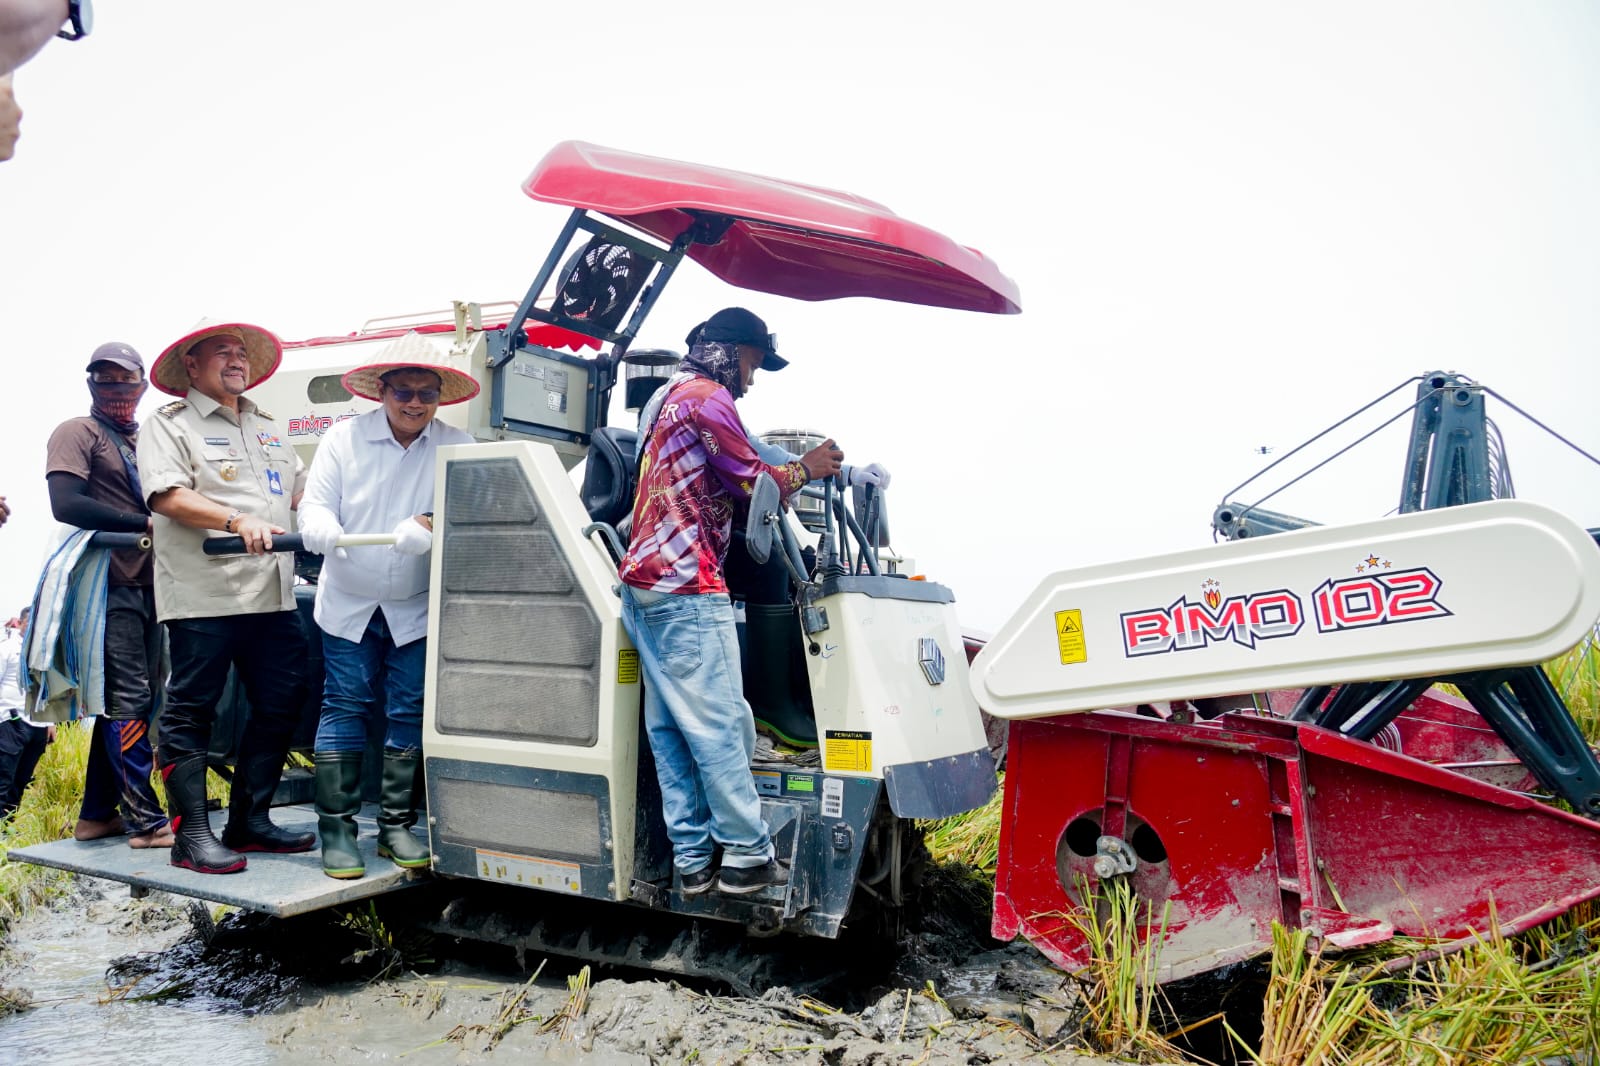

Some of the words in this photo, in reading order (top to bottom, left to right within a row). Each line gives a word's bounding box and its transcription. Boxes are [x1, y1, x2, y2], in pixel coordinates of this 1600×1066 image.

[288, 416, 333, 437] BIMO
[1120, 590, 1305, 658] BIMO
[1312, 567, 1454, 633] 102
